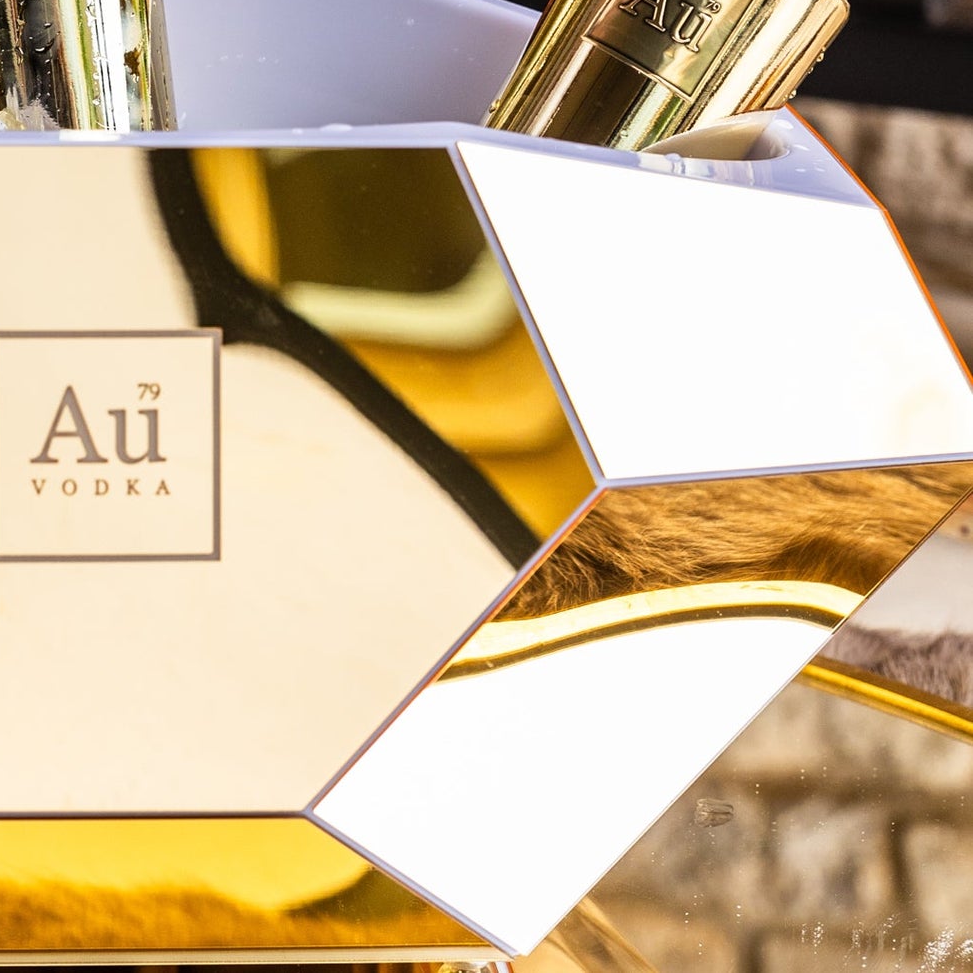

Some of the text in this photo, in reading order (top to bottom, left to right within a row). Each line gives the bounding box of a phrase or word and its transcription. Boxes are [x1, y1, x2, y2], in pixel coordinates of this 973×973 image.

[137, 383, 161, 401] 79
[30, 385, 167, 464] Au
[31, 478, 171, 496] VODKA
